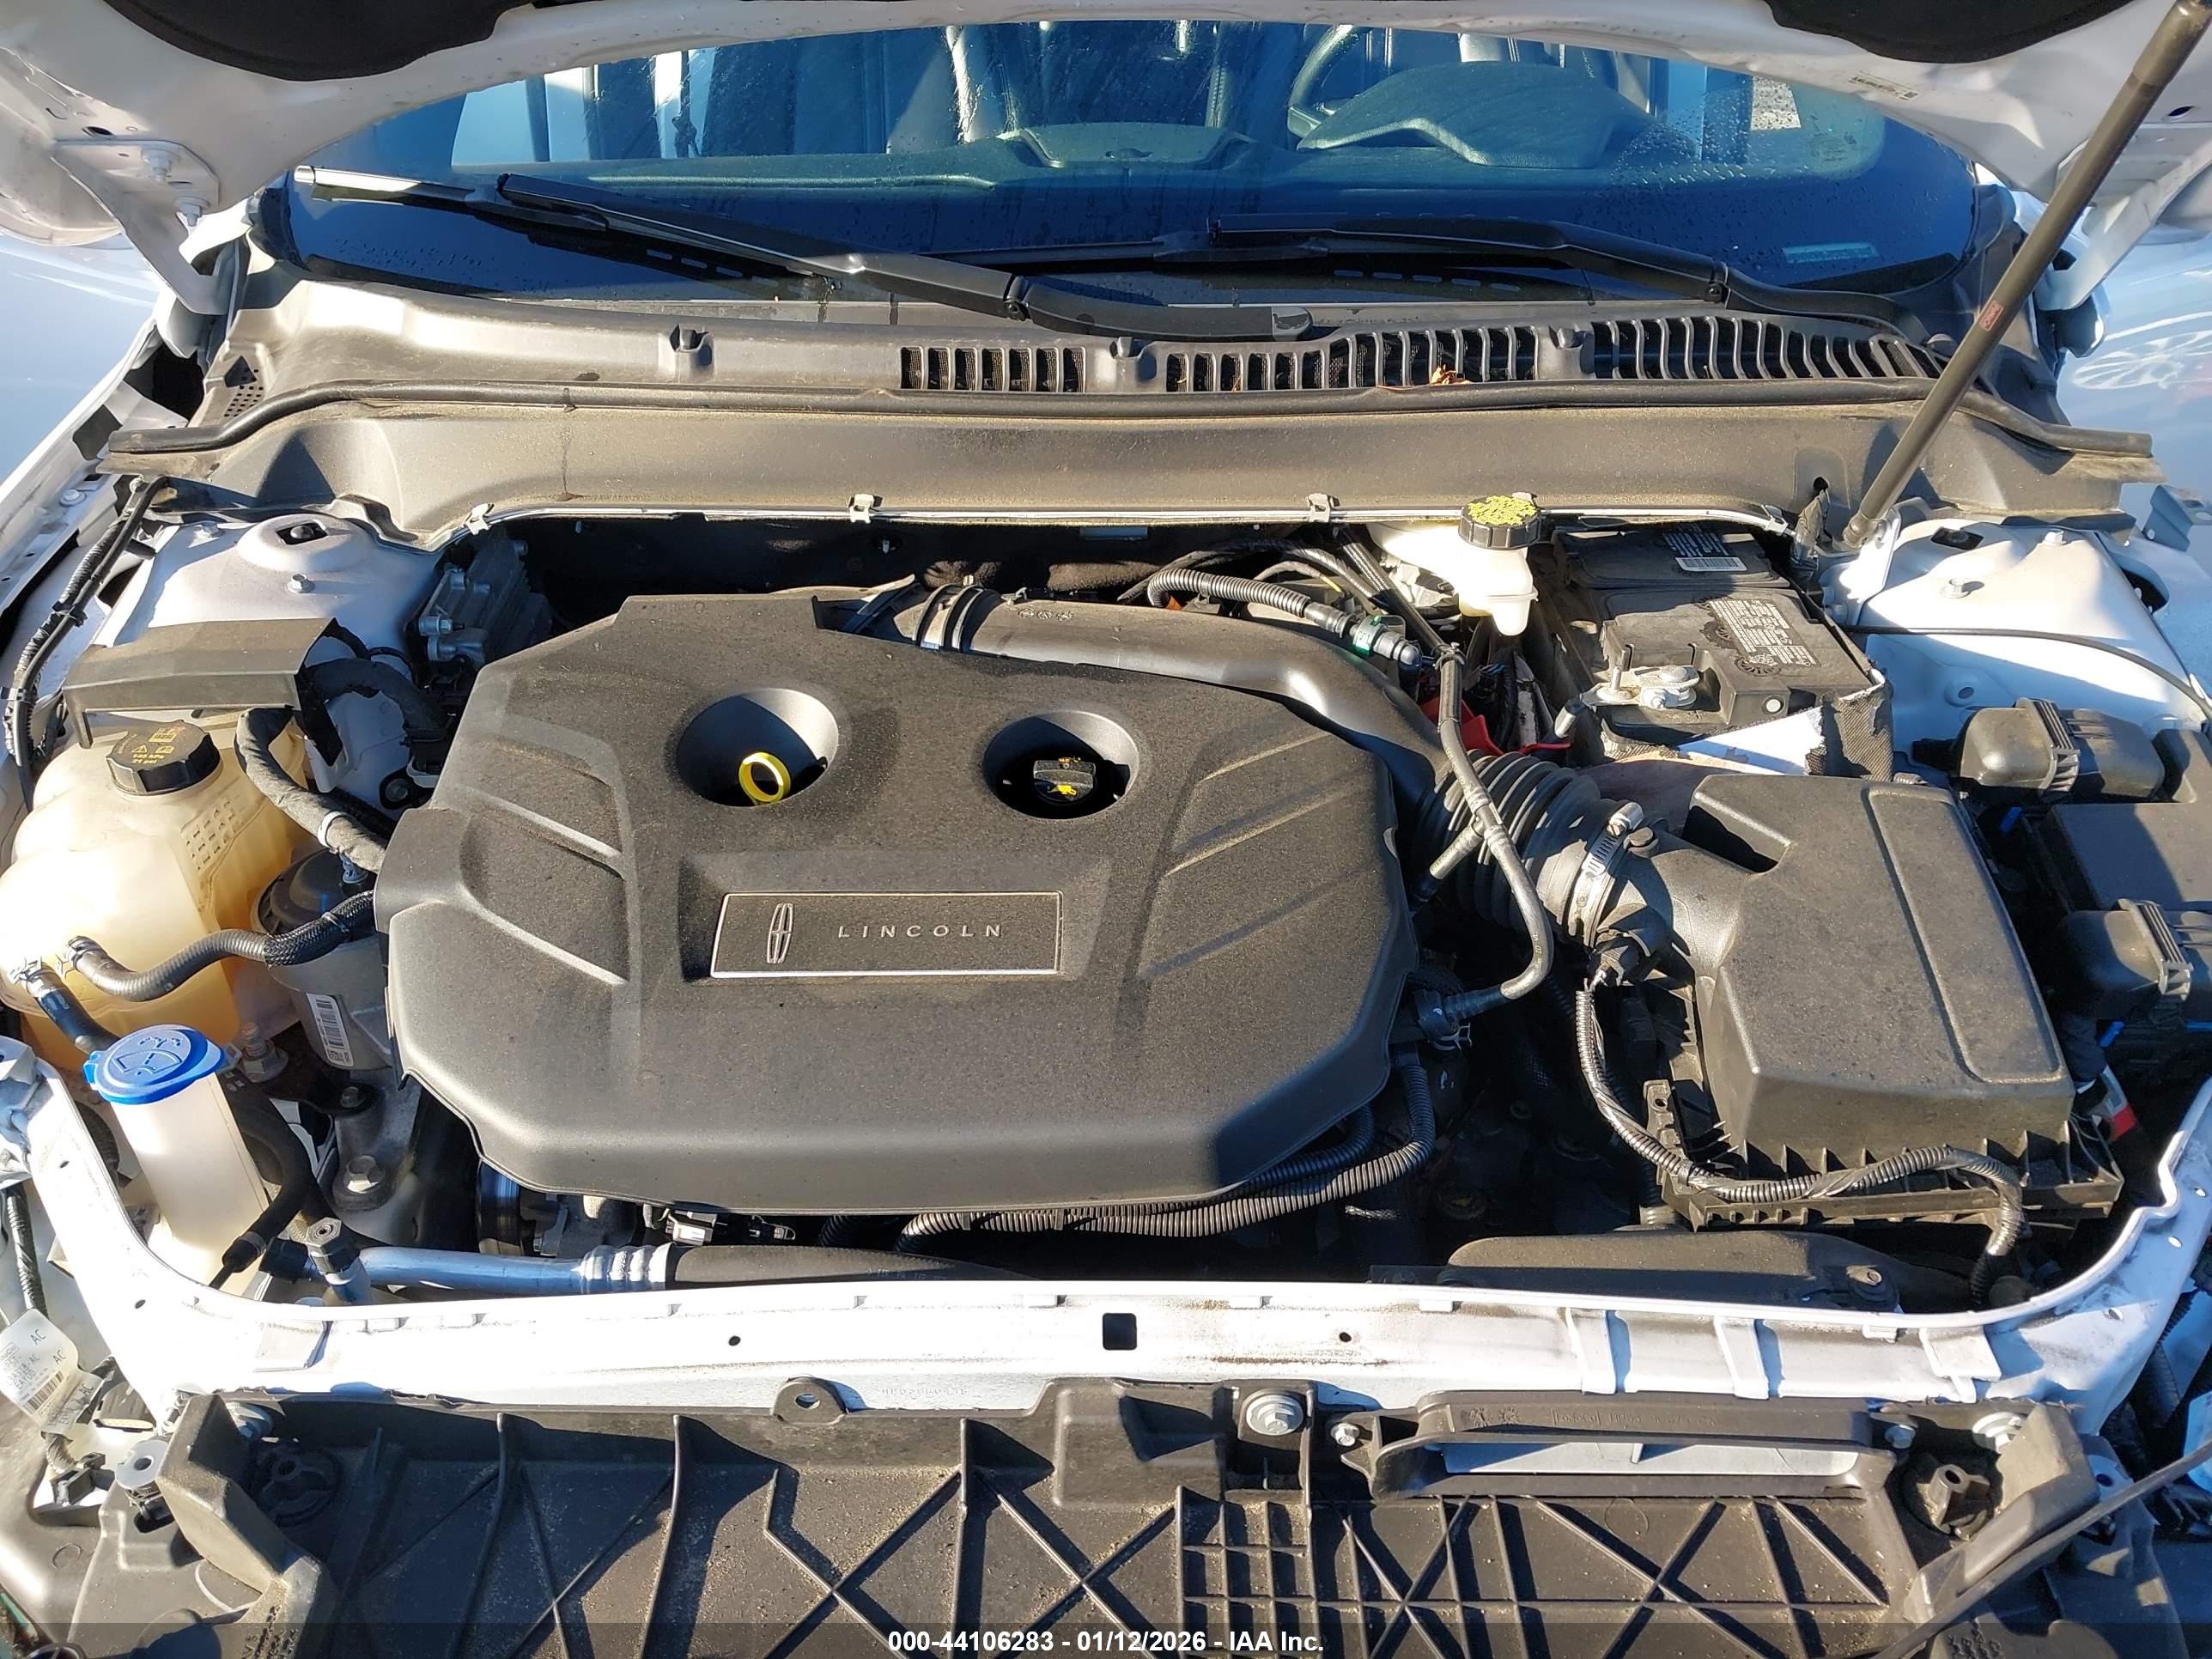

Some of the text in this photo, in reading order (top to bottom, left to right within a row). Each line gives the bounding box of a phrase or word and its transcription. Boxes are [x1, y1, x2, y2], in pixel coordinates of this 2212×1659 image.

[838, 925, 1003, 938] LINCOLN
[30, 1328, 46, 1346] AC
[52, 1349, 67, 1365] AC
[79, 1382, 94, 1395] AC
